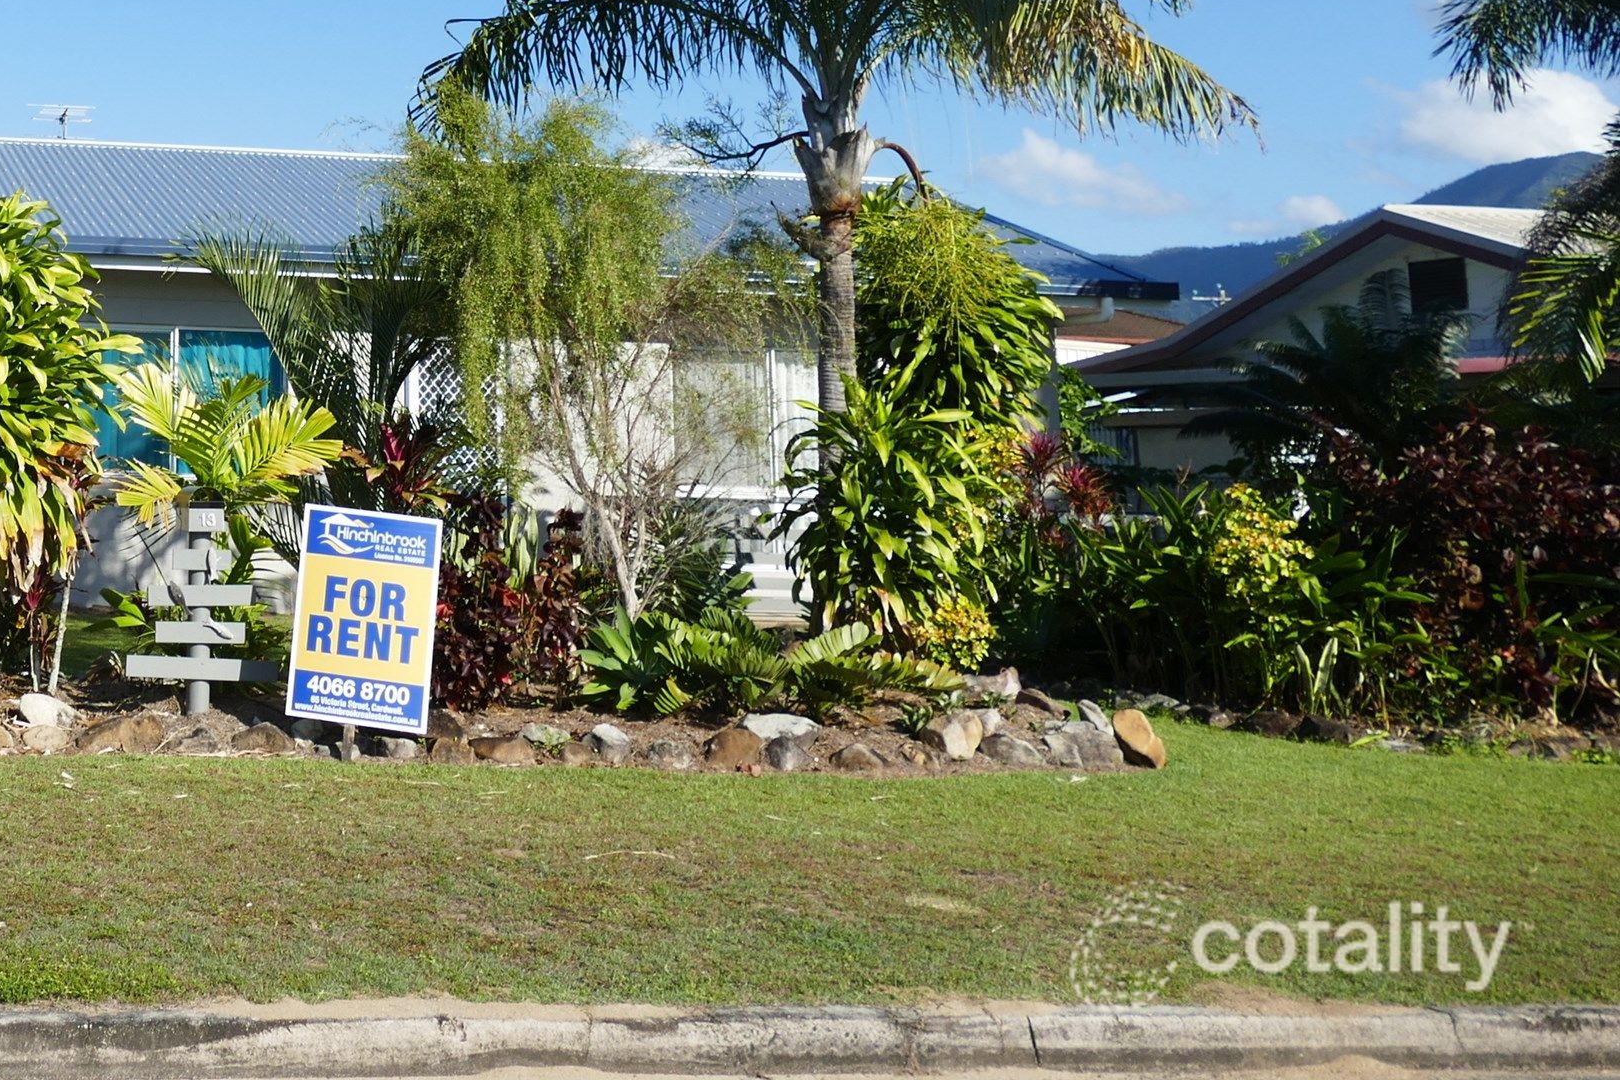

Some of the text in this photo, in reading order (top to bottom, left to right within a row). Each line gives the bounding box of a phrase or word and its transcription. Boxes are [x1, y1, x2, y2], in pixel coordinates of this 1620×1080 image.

[198, 512, 216, 527] 13
[336, 525, 427, 549] Hinchinbrook
[374, 544, 426, 557] REAL ESTATE
[323, 575, 407, 622] FOR
[306, 614, 419, 665] RENT
[306, 674, 411, 706] 4066 8700
[320, 695, 347, 709] Victoria
